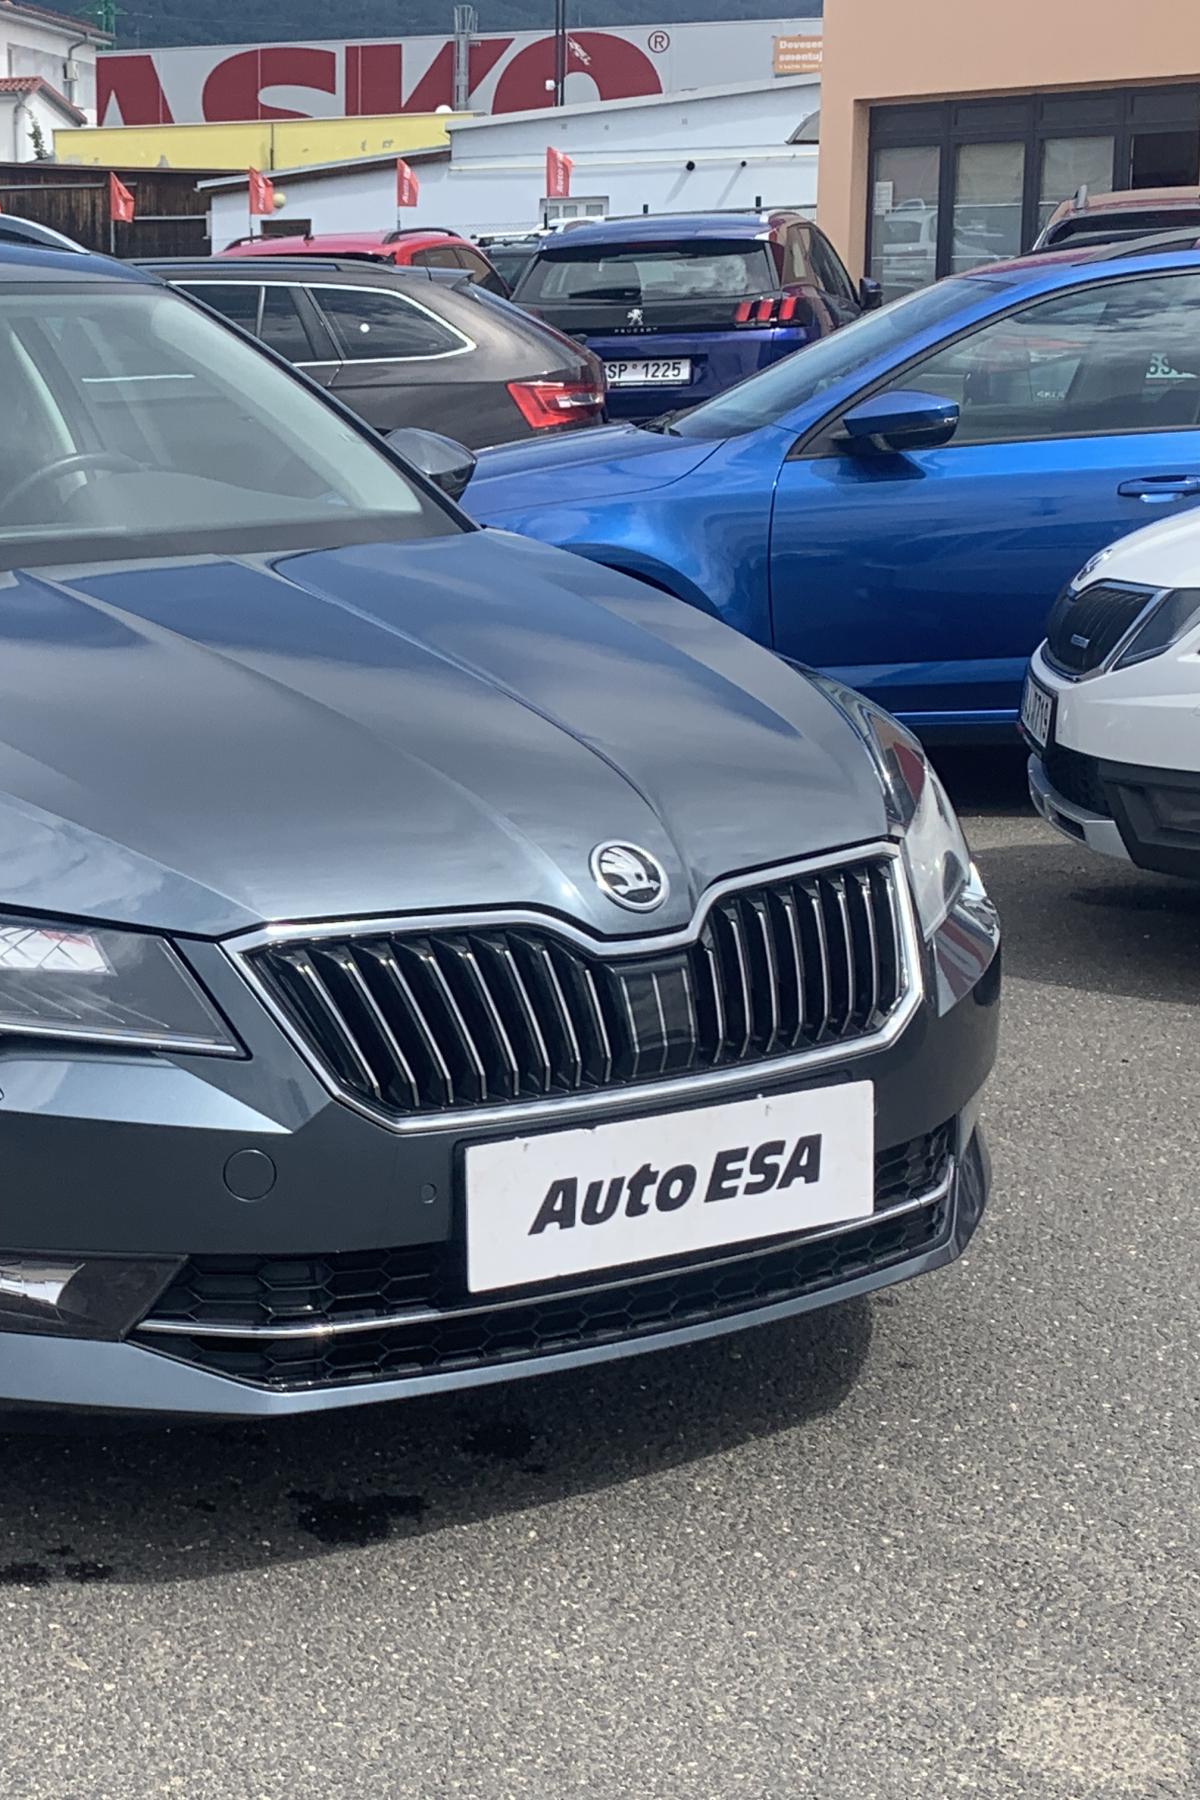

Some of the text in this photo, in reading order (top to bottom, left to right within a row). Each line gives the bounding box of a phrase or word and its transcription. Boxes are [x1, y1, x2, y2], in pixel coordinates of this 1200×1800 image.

[604, 361, 682, 379] SP 1225
[528, 1133, 822, 1236] Auto ESA
